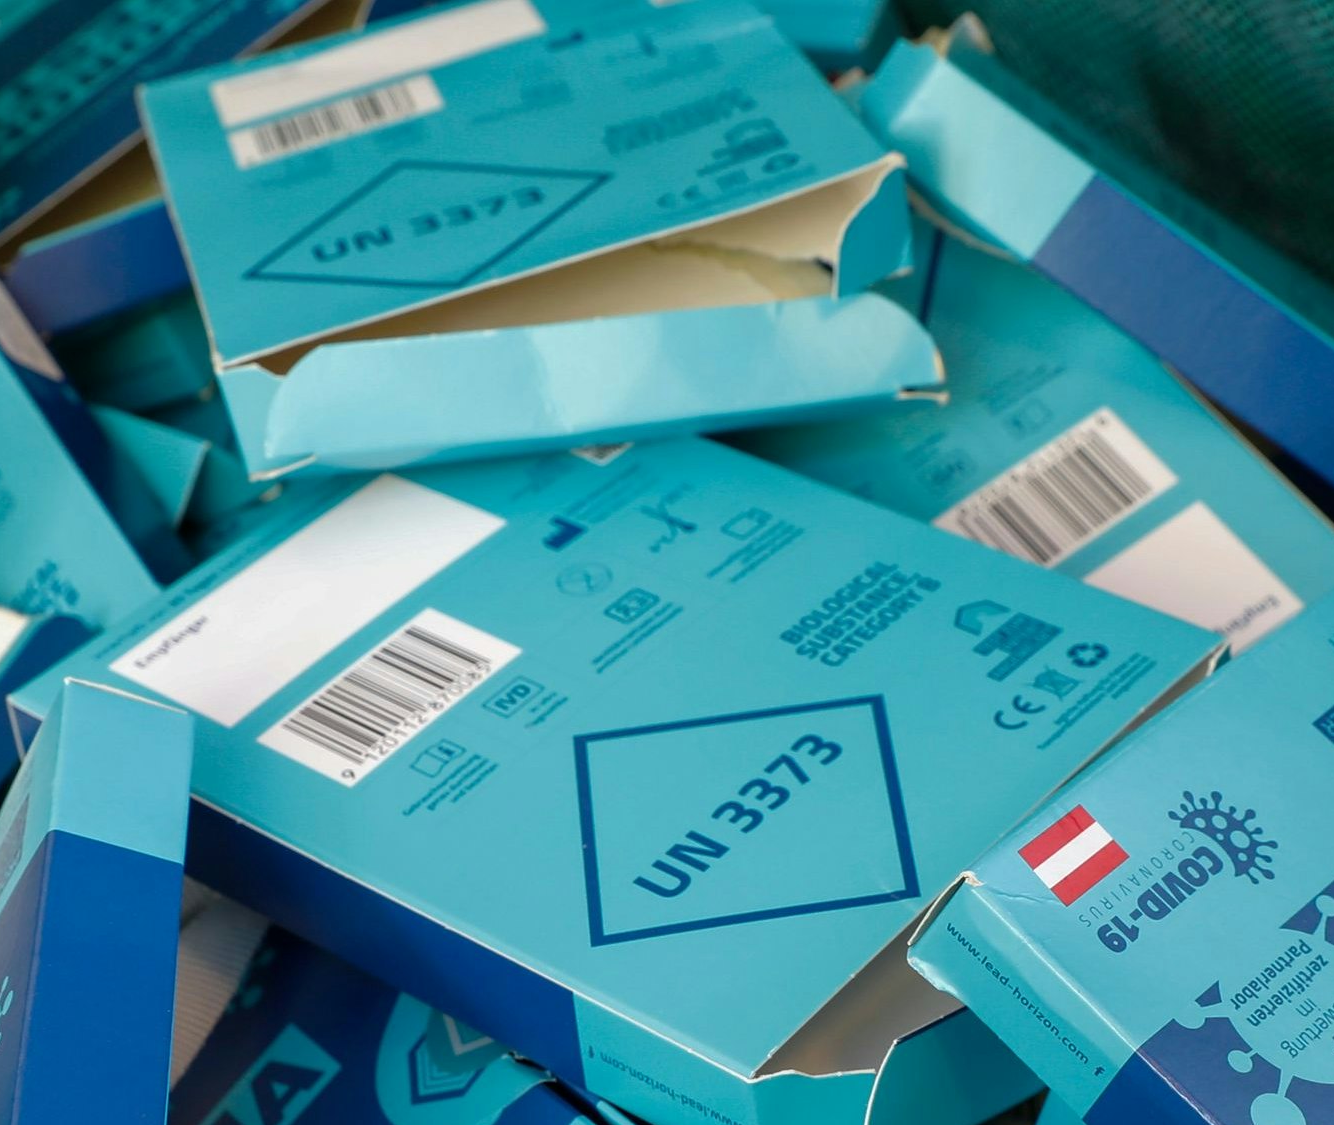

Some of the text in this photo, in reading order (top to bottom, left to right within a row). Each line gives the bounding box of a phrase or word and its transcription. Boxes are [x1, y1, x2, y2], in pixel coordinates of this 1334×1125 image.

[312, 186, 545, 262] UN 3373
[779, 561, 900, 645] BIOLOGICAL
[820, 589, 923, 667] CATEGORY
[632, 733, 843, 898] UN 3373
[1078, 831, 1195, 928] CORONAVIRUS
[1097, 846, 1224, 953] COVID-19
[946, 922, 1089, 1065] www.lead-horizon.com
[1230, 939, 1313, 1010] Partnerlabor
[1246, 954, 1330, 1027] zertifizierten
[1295, 998, 1322, 1017] im
